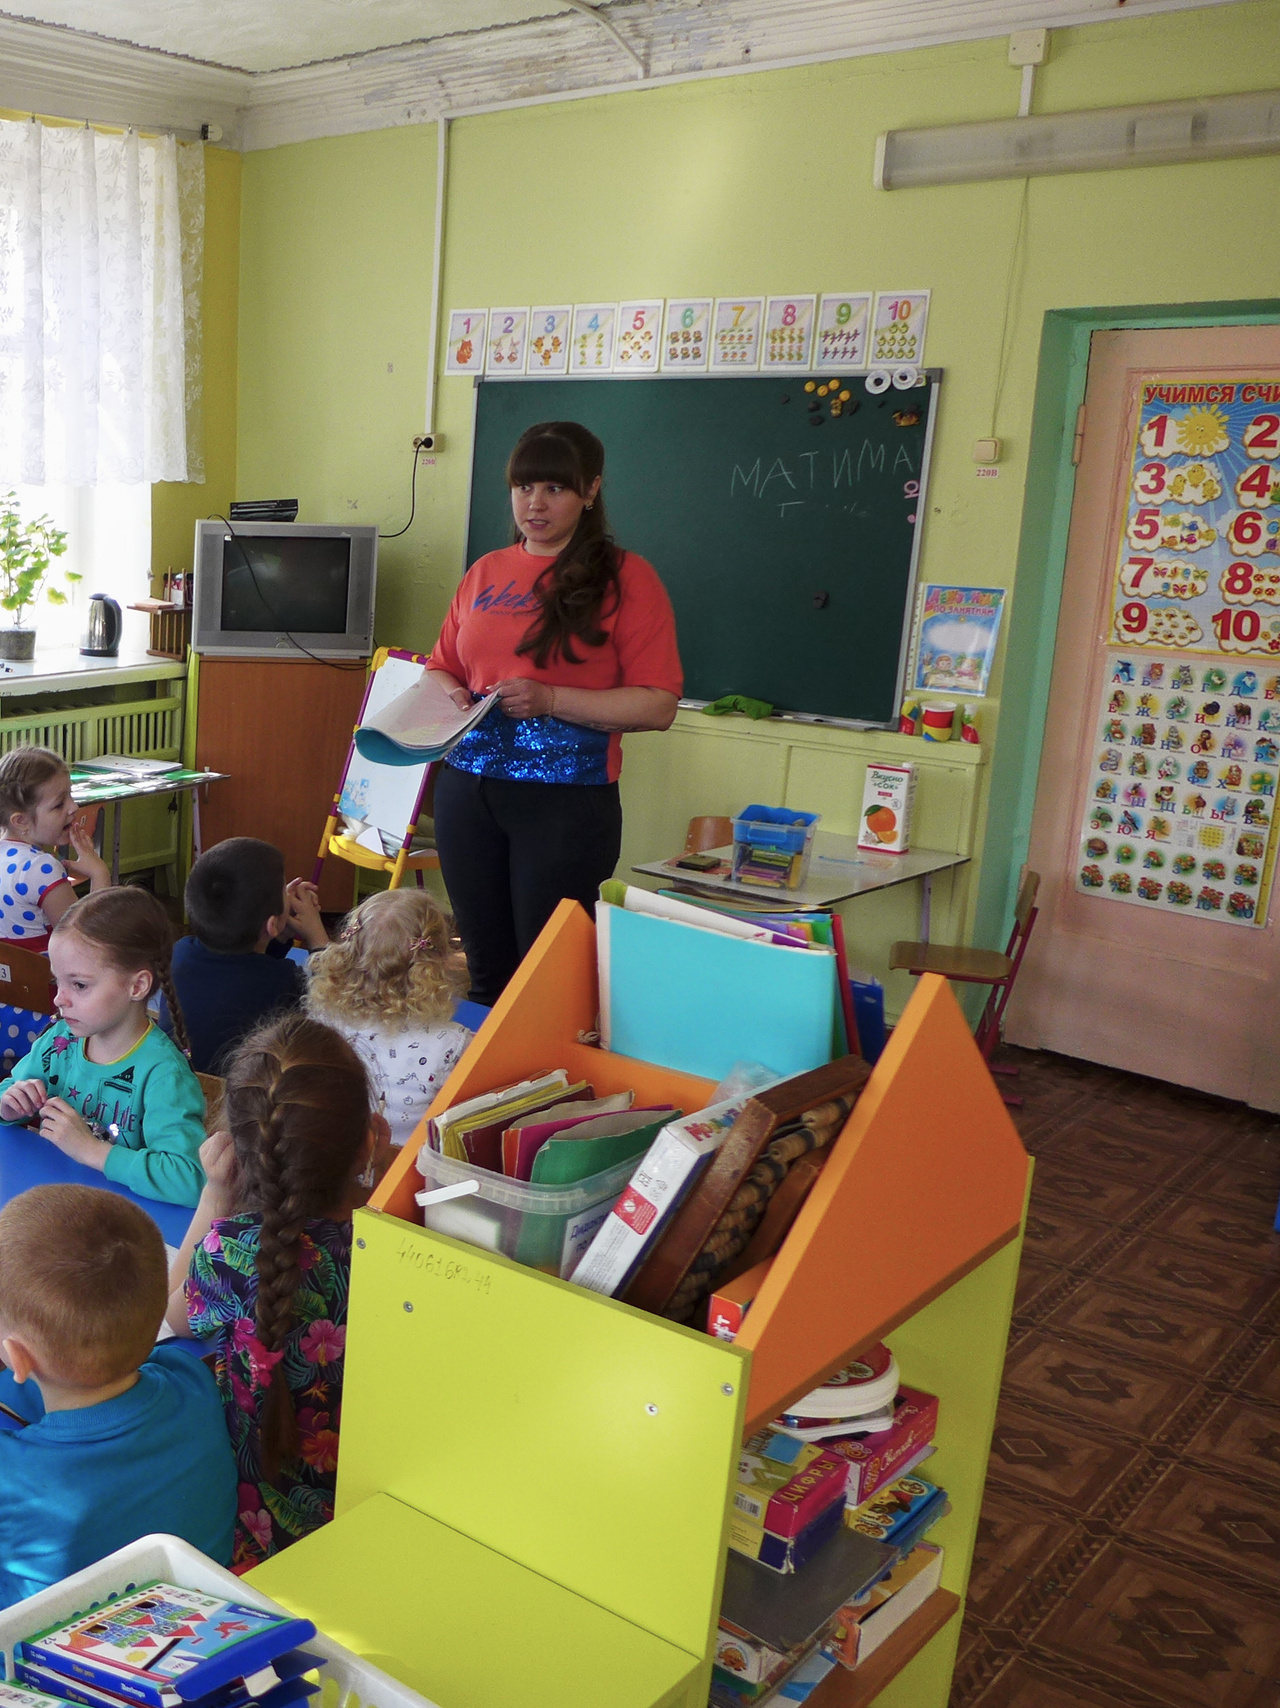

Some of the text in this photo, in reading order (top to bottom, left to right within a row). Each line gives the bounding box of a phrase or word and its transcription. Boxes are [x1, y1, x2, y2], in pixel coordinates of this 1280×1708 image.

[731, 305, 745, 327] 7
[782, 304, 796, 326] 8
[836, 302, 852, 325] 9
[888, 300, 911, 321] 10
[588, 313, 600, 332] 4
[633, 310, 645, 330] 5
[681, 307, 694, 328] 6
[463, 318, 471, 334] 1
[503, 316, 514, 334] 2
[544, 315, 556, 333] 3
[1145, 385, 1235, 404] УЧИМСЯ
[1147, 415, 1168, 448] 1
[1248, 414, 1279, 448] 2
[1139, 462, 1166, 495] 3
[1240, 465, 1271, 498] 4
[1133, 508, 1160, 540] 5
[1233, 511, 1263, 545] 6
[1128, 557, 1154, 588] 7
[1225, 562, 1253, 595] 8
[1122, 602, 1148, 633] 9
[1211, 608, 1260, 642] 10
[1111, 673, 1121, 683] А
[1141, 676, 1151, 686] Б
[1171, 680, 1180, 689] В
[1201, 683, 1210, 692] Г
[1228, 686, 1241, 697] Д
[1264, 689, 1275, 700] Е
[1135, 706, 1151, 717] Ж
[1166, 710, 1175, 719] З
[1194, 713, 1206, 724] И
[1225, 713, 1236, 727] Й
[1257, 721, 1268, 731] К
[1103, 733, 1113, 742] Л
[1130, 736, 1142, 746] М
[1160, 740, 1170, 750] Н
[1191, 743, 1201, 754] О
[1221, 748, 1232, 758] П
[1254, 752, 1264, 762] Р
[1100, 762, 1109, 771] С
[1129, 766, 1137, 776] Т
[1157, 769, 1167, 780] У
[1187, 775, 1200, 785] Ф
[1216, 779, 1227, 789] Х
[1262, 785, 1274, 797] Ц
[1108, 793, 1117, 803] Ч
[1131, 797, 1146, 808] Ш
[1160, 801, 1176, 814] Щ
[1210, 809, 1226, 820] Ы
[1090, 820, 1100, 830] Э
[1116, 824, 1132, 835] Ю
[1145, 829, 1156, 840] Я
[1, 967, 7, 978] 3
[780, 1460, 837, 1501] ЦИФРЫ
